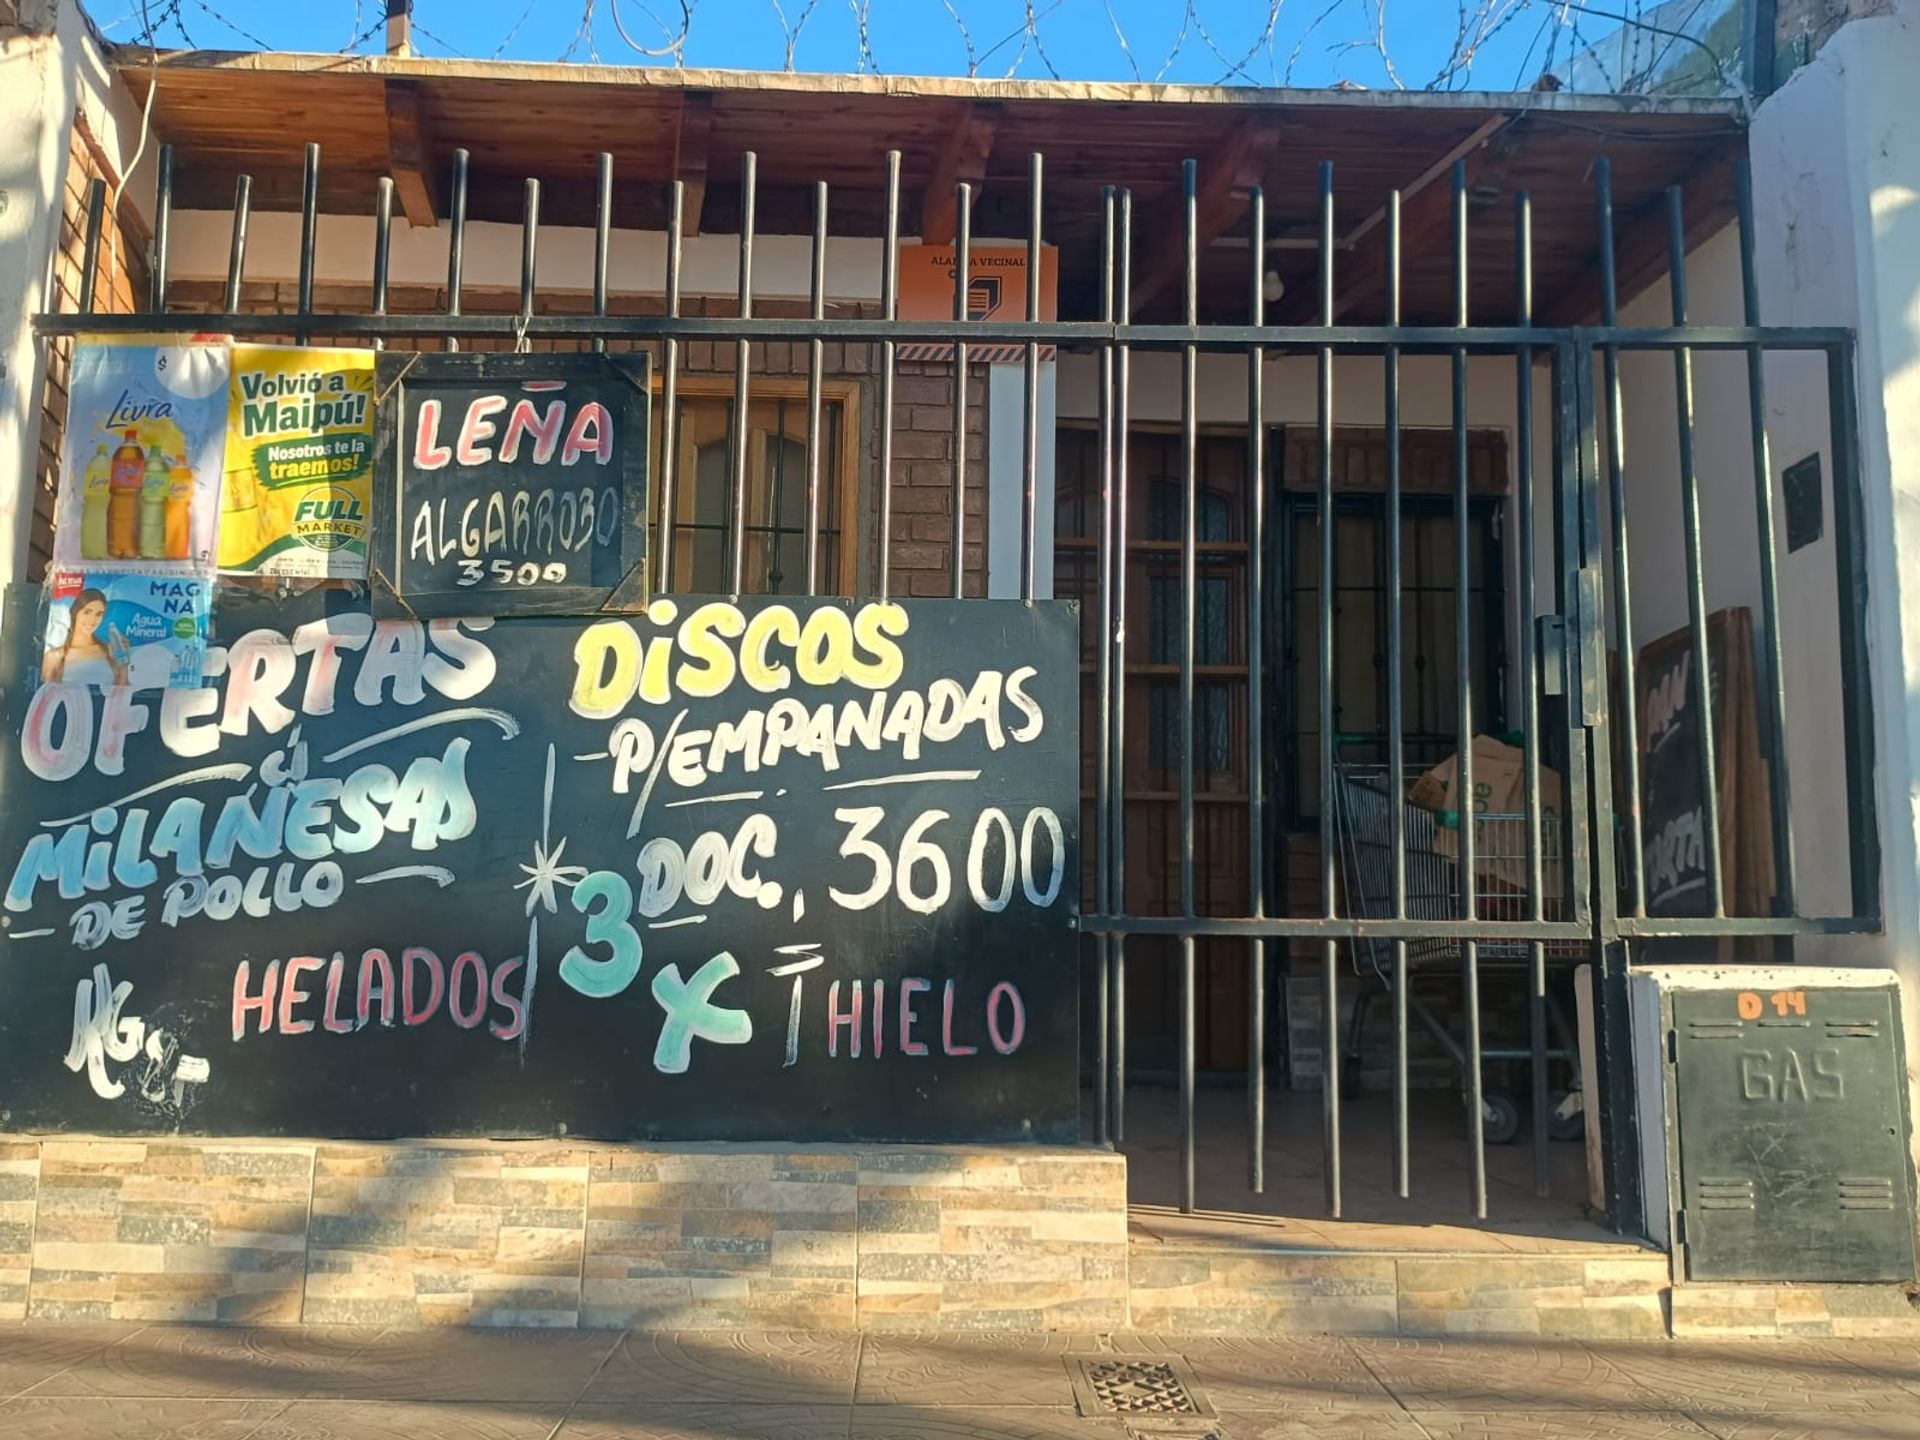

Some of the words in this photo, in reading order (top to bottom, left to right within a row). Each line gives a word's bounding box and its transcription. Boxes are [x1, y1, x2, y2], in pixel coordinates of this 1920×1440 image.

[931, 256, 977, 267] ALAA
[979, 257, 1026, 268] VECINAL
[240, 371, 323, 401] Volvió
[328, 374, 345, 393] a
[105, 389, 174, 430] Livra
[242, 392, 367, 438] Maipú!
[412, 380, 614, 470] LEÑA
[267, 443, 333, 462] Nosotros
[334, 440, 349, 455] te
[351, 438, 365, 453] la
[268, 453, 360, 481] traemos!
[294, 500, 364, 522] FULL
[410, 486, 619, 567] ALGARROBO
[296, 521, 362, 537] MARKET
[150, 580, 201, 598] MAG
[456, 558, 567, 587] 3500
[131, 612, 162, 628] Agua
[163, 598, 194, 614] NA
[125, 625, 167, 639] Mineral
[20, 612, 498, 782] OFERTAS
[828, 806, 1065, 916] 3600
[69, 894, 146, 950] DE
[161, 860, 345, 928] POLLO
[558, 870, 644, 998] 3
[231, 947, 524, 1042] HELADOS
[827, 976, 1027, 1059] HIELO
[1738, 1046, 1846, 1102] GAS
